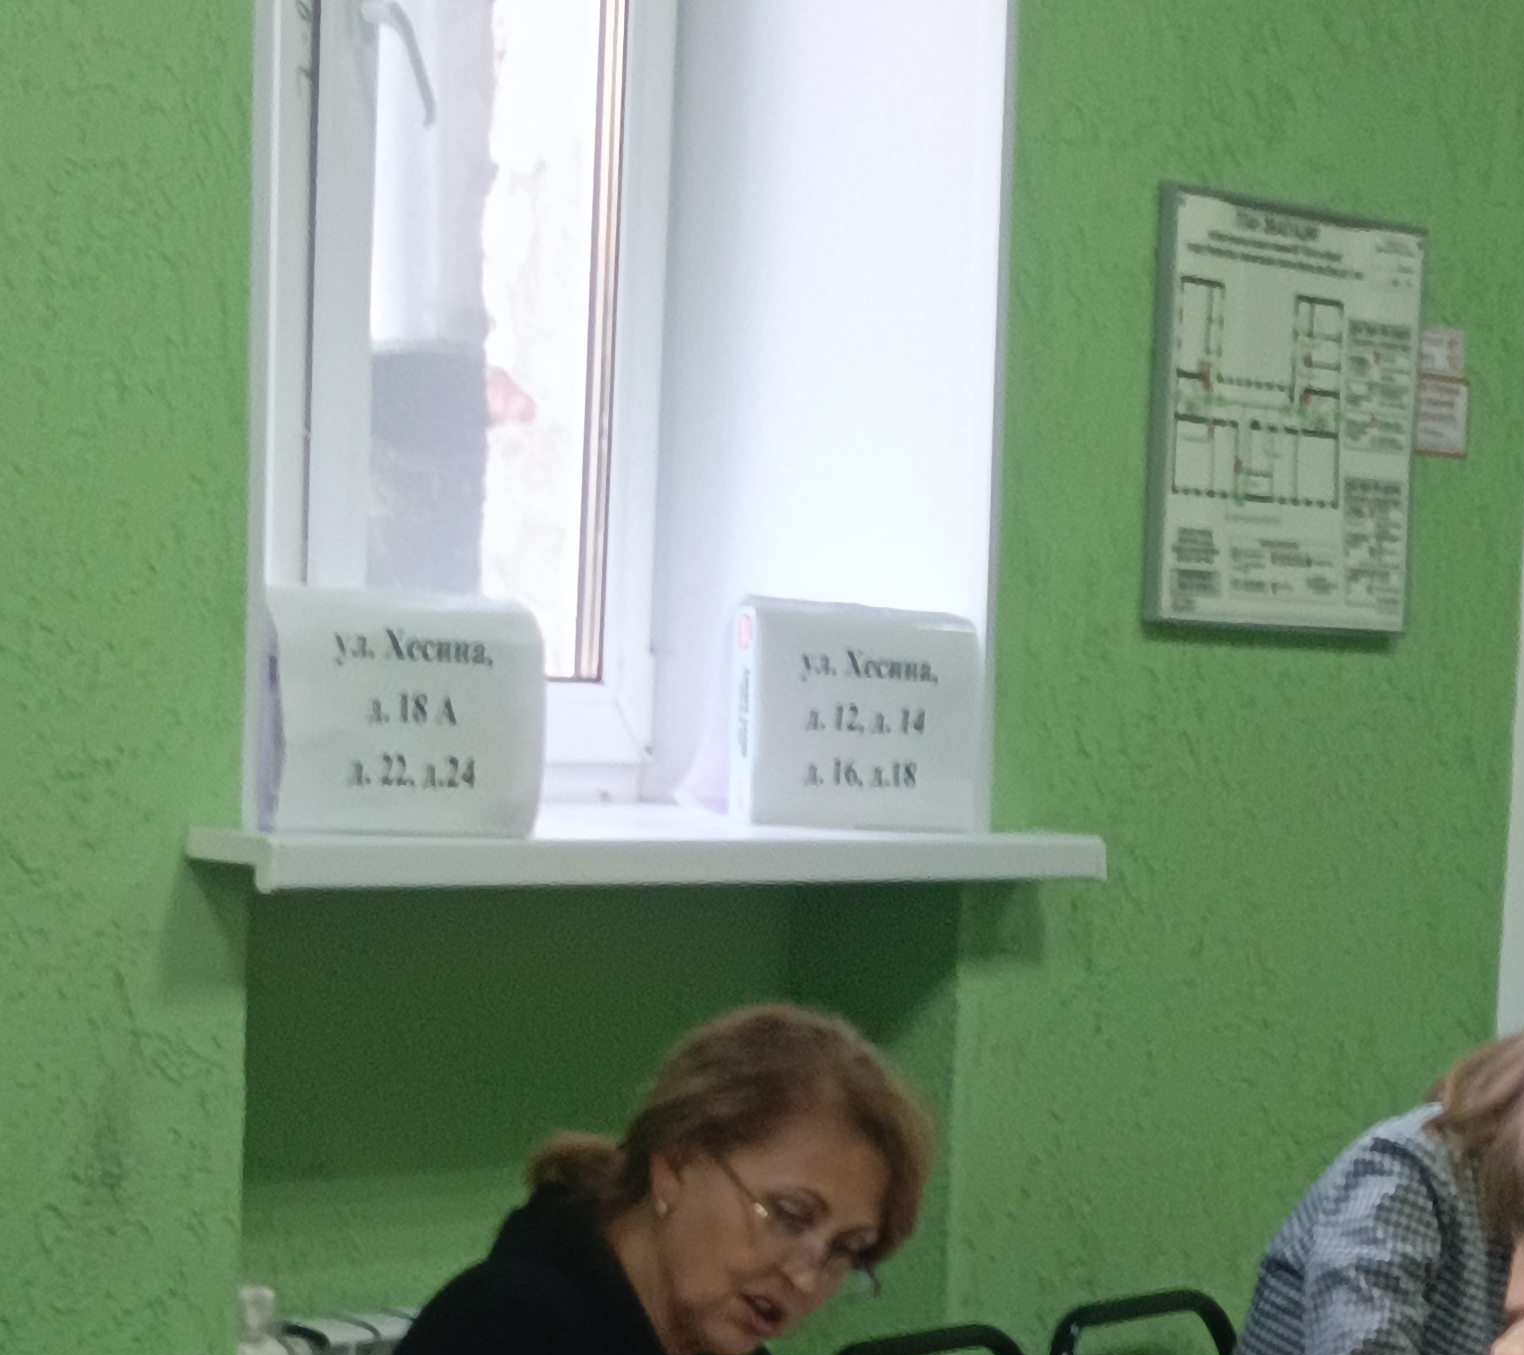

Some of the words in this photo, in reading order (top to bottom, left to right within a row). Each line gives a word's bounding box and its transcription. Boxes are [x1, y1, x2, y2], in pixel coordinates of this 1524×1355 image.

[333, 632, 375, 667] ул.
[800, 653, 838, 682] ул.
[399, 691, 429, 724] 18
[435, 695, 457, 726] А
[901, 706, 926, 735] 14
